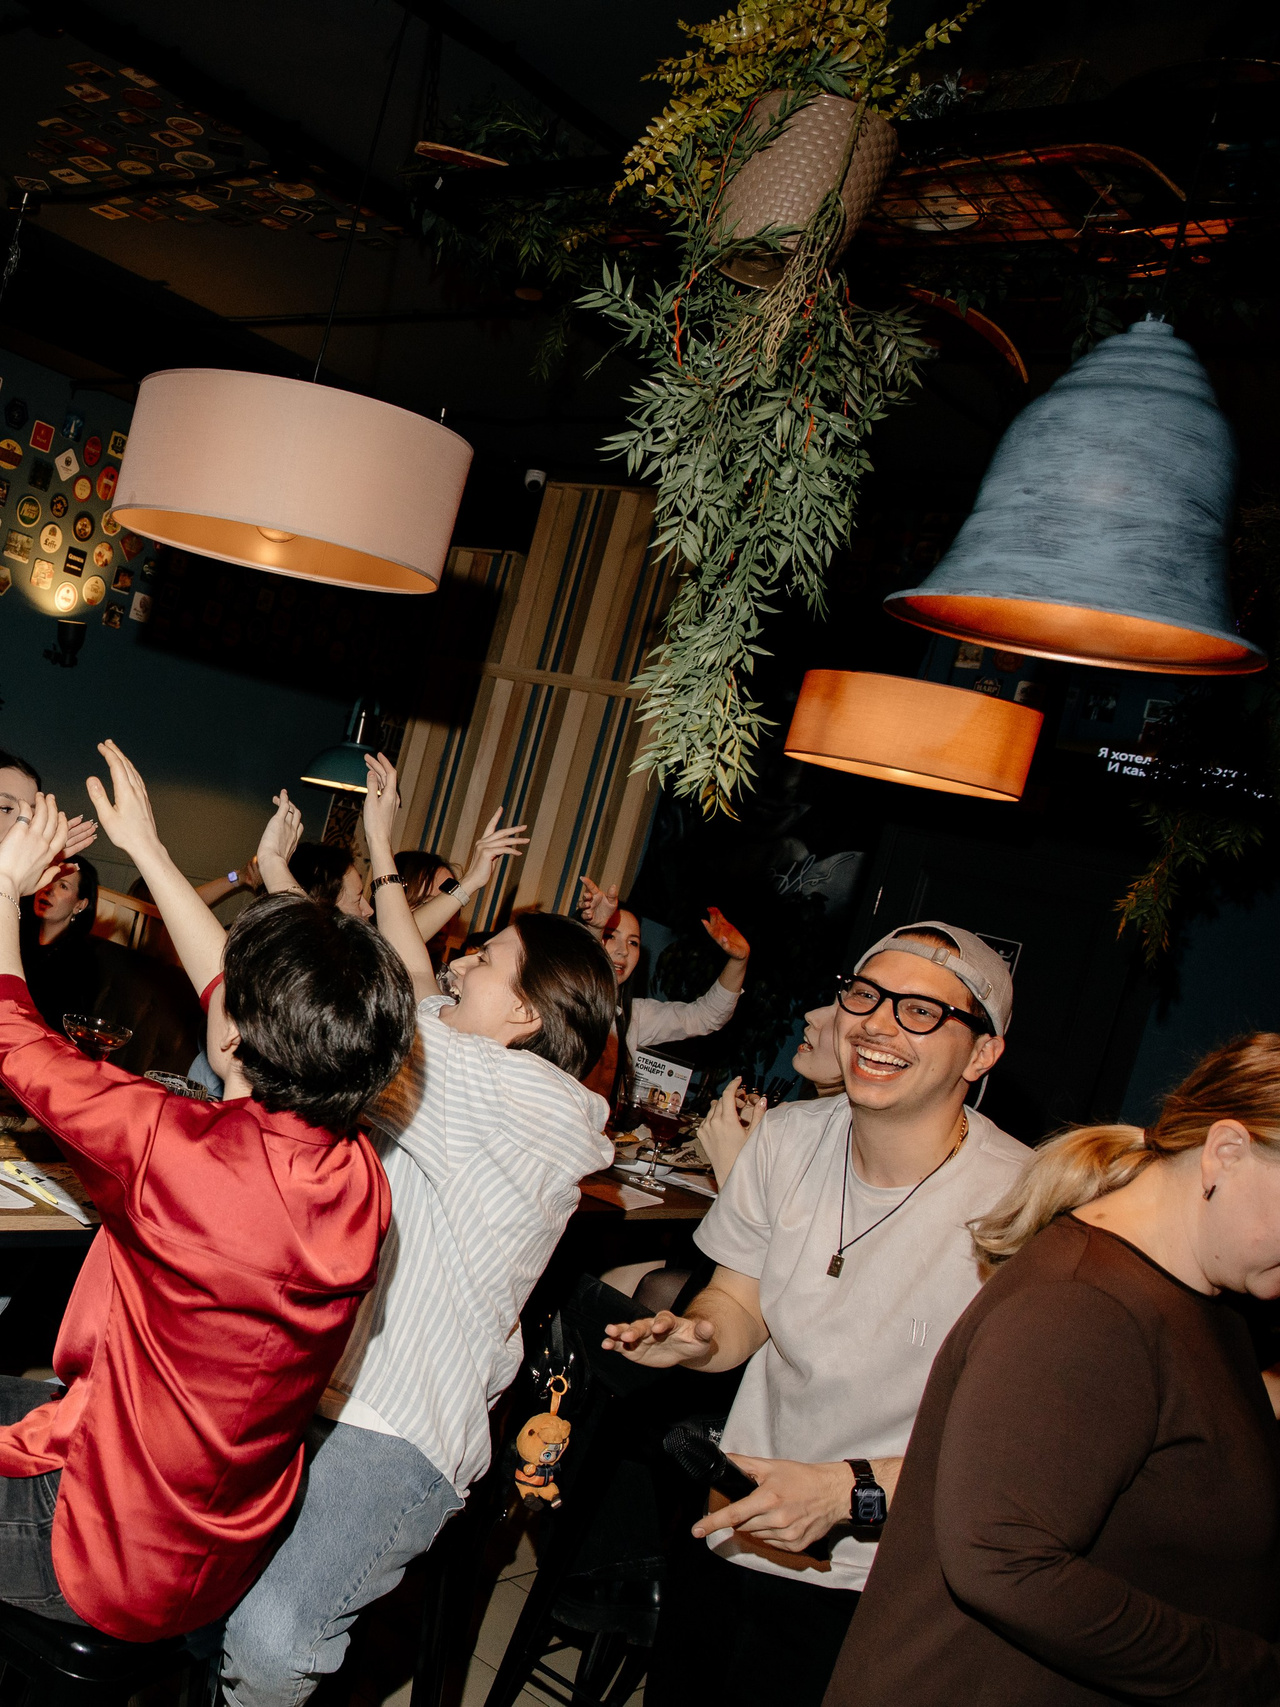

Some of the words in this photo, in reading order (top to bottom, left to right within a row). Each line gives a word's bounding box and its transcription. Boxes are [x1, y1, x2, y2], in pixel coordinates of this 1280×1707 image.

[44, 538, 57, 548] Leffe
[1098, 747, 1110, 758] Я
[1106, 761, 1120, 773] И
[635, 1062, 664, 1076] КОНЦЕРТ
[638, 1056, 666, 1070] СТЕНДАП
